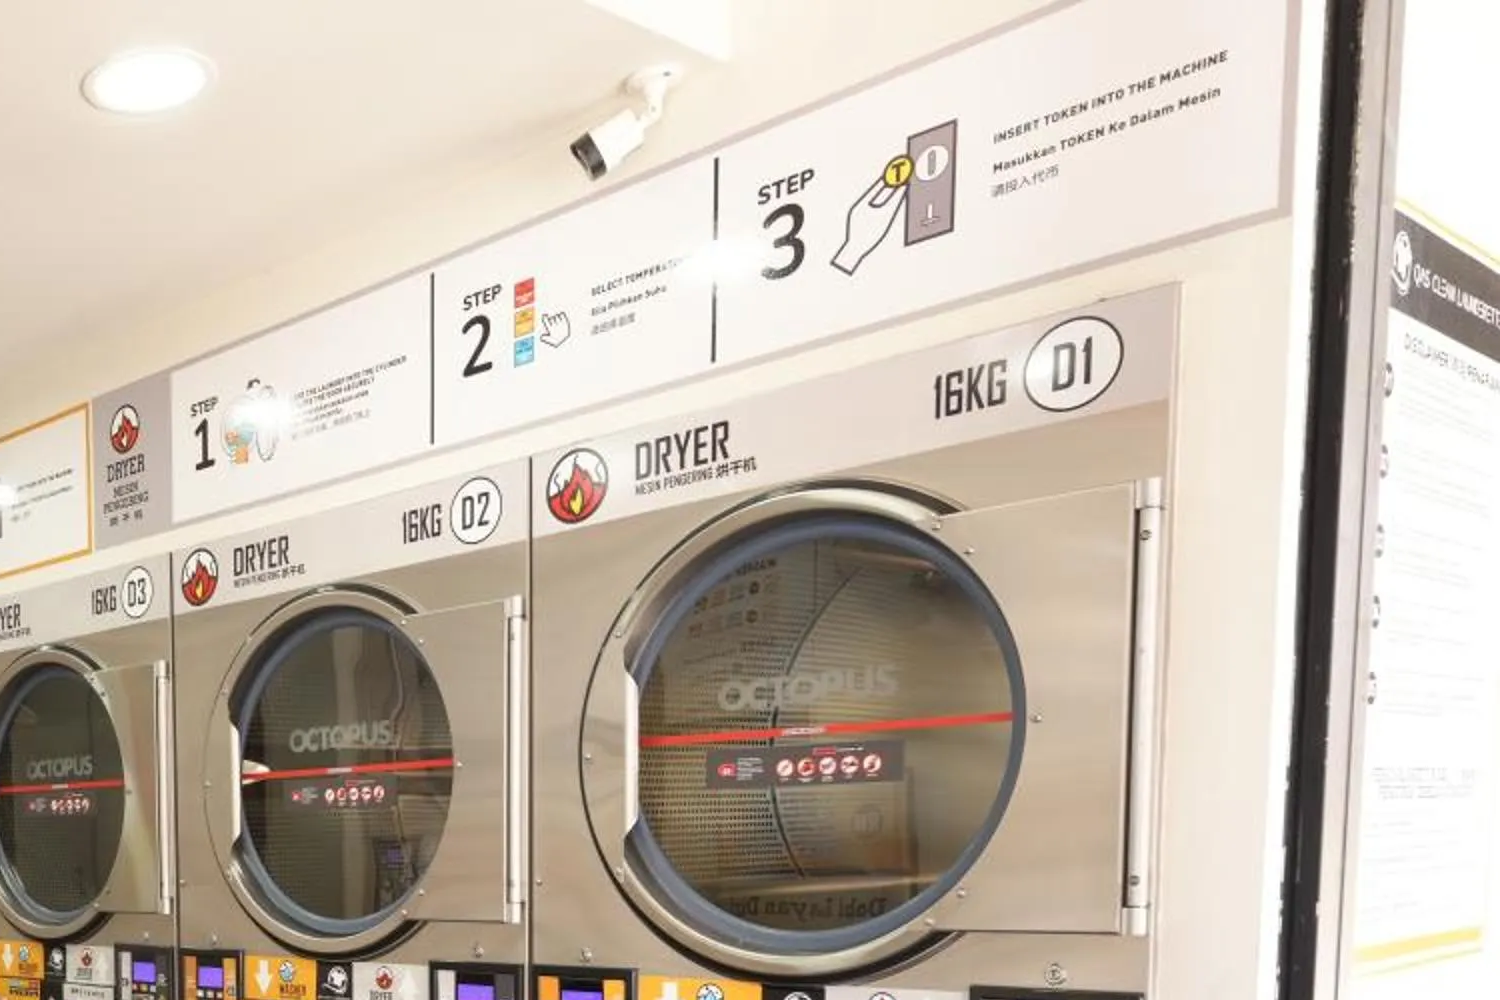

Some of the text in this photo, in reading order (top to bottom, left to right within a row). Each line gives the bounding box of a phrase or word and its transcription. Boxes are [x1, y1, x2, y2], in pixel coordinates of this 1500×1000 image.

[993, 49, 1229, 144] INSERT TOKEN INTO THE MACHINE
[993, 86, 1221, 174] Masukkan TOKEN Ke Dalam Mesin
[758, 168, 815, 205] STEP
[761, 203, 806, 280] 3
[462, 284, 502, 311] STEP
[461, 314, 492, 378] 2
[1051, 335, 1095, 393] D1
[191, 397, 219, 417] STEP
[933, 359, 1009, 420] 16KG
[194, 418, 216, 471] 1
[634, 419, 730, 482] DRYER
[107, 453, 145, 483] DRYER
[403, 504, 442, 544] 16KG
[461, 491, 491, 531] D2
[233, 535, 289, 577] DRYER
[91, 585, 117, 616] 16KG
[127, 577, 148, 608] D3
[717, 663, 898, 711] OCTOPUS
[289, 718, 392, 752] OCTOPUS
[26, 754, 94, 780] OCTOPUS
